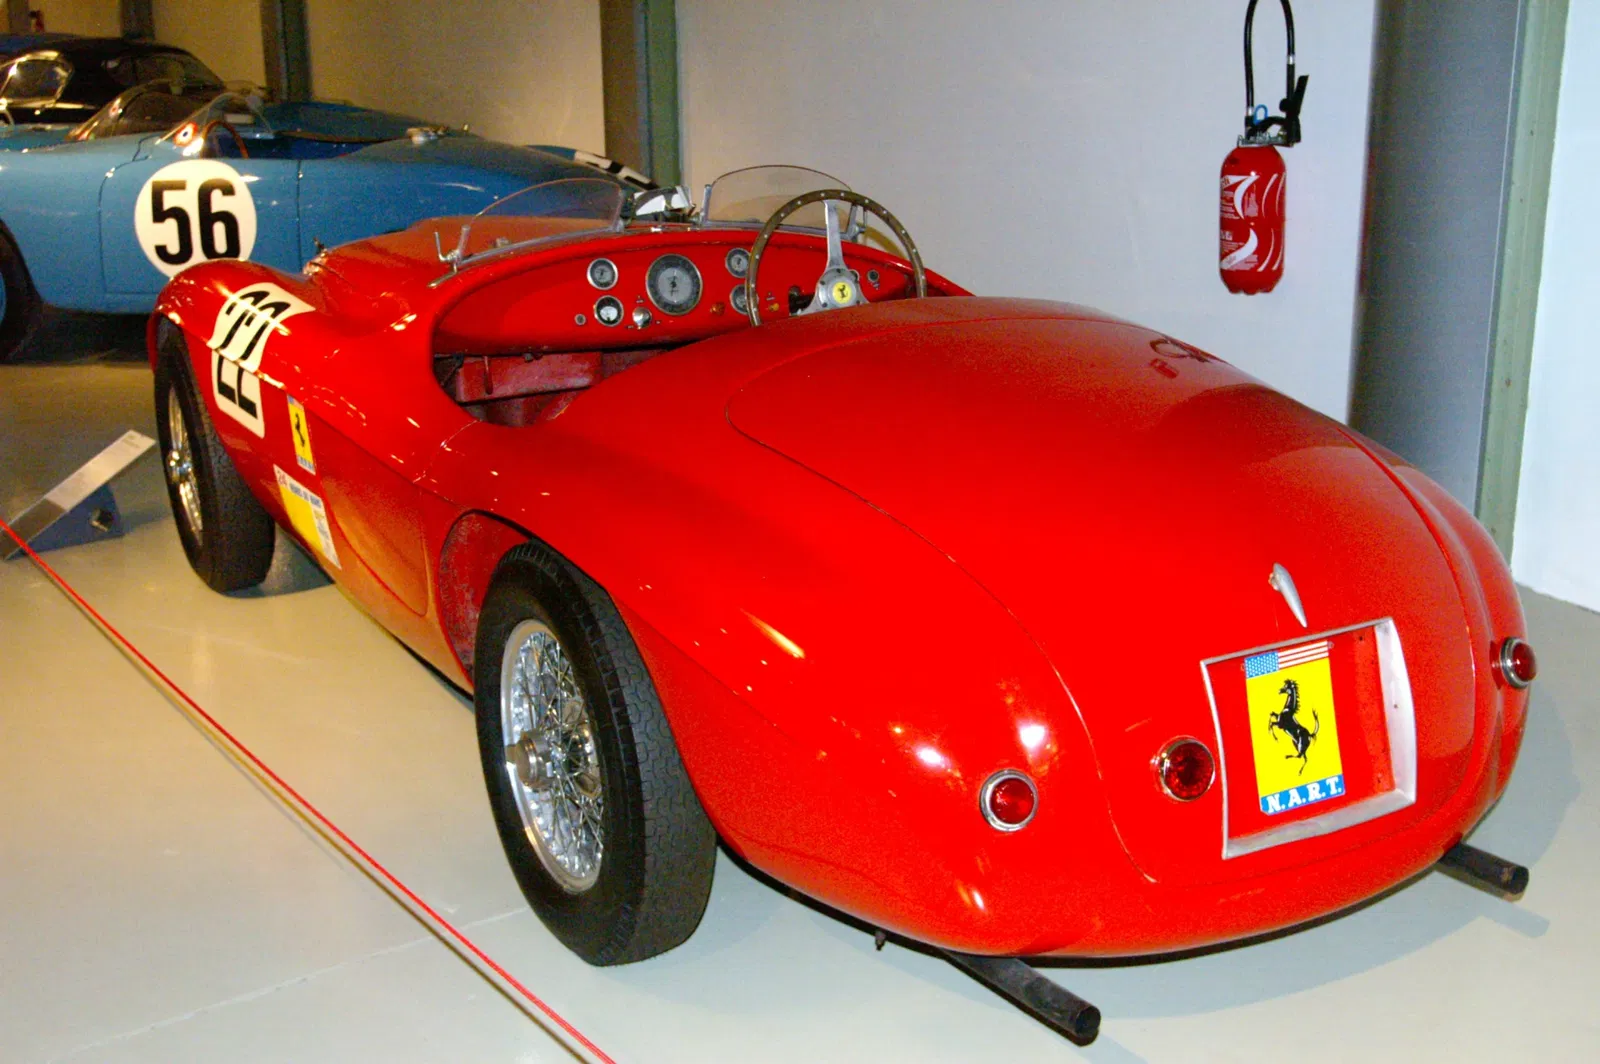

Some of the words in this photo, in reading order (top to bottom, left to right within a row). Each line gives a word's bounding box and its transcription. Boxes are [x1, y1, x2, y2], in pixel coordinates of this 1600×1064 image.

[151, 178, 241, 265] 56
[217, 291, 291, 420] 22
[1266, 776, 1342, 813] N.A.R.T.
